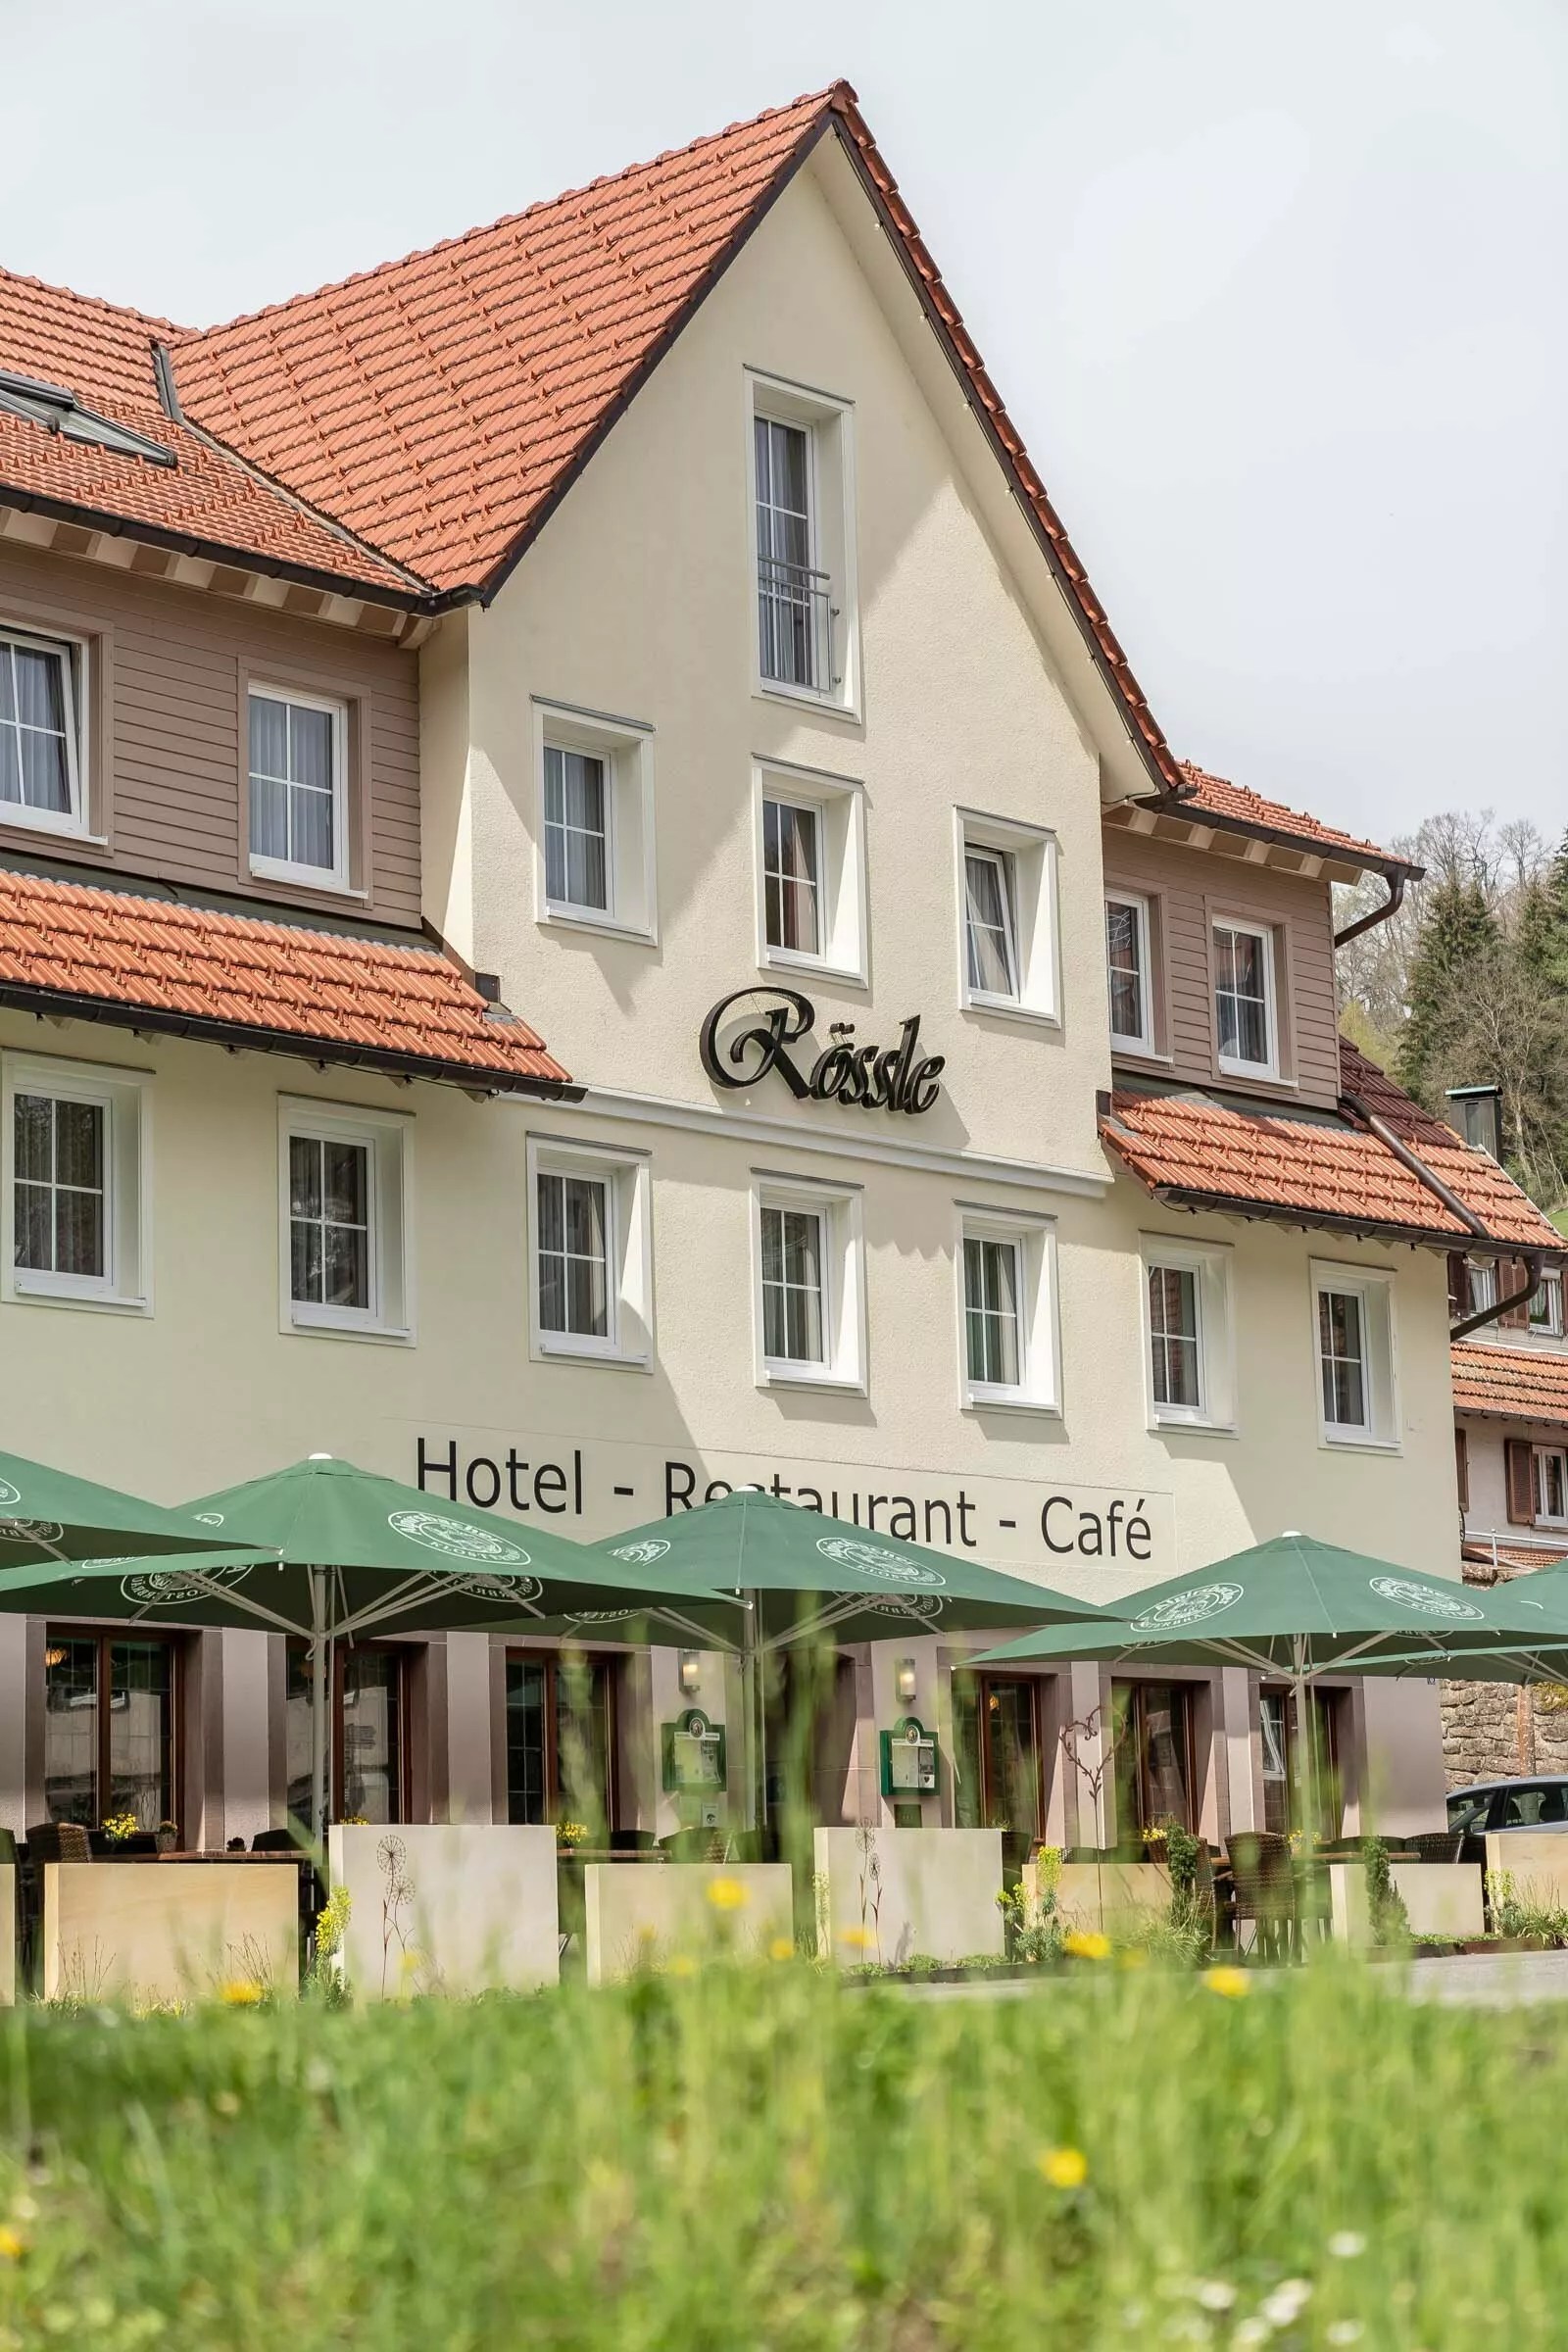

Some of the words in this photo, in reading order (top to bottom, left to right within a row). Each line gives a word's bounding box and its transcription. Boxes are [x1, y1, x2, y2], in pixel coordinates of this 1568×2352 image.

[699, 986, 946, 1115] Rössle
[416, 1437, 583, 1516] Hotel
[1041, 1498, 1152, 1560] Café
